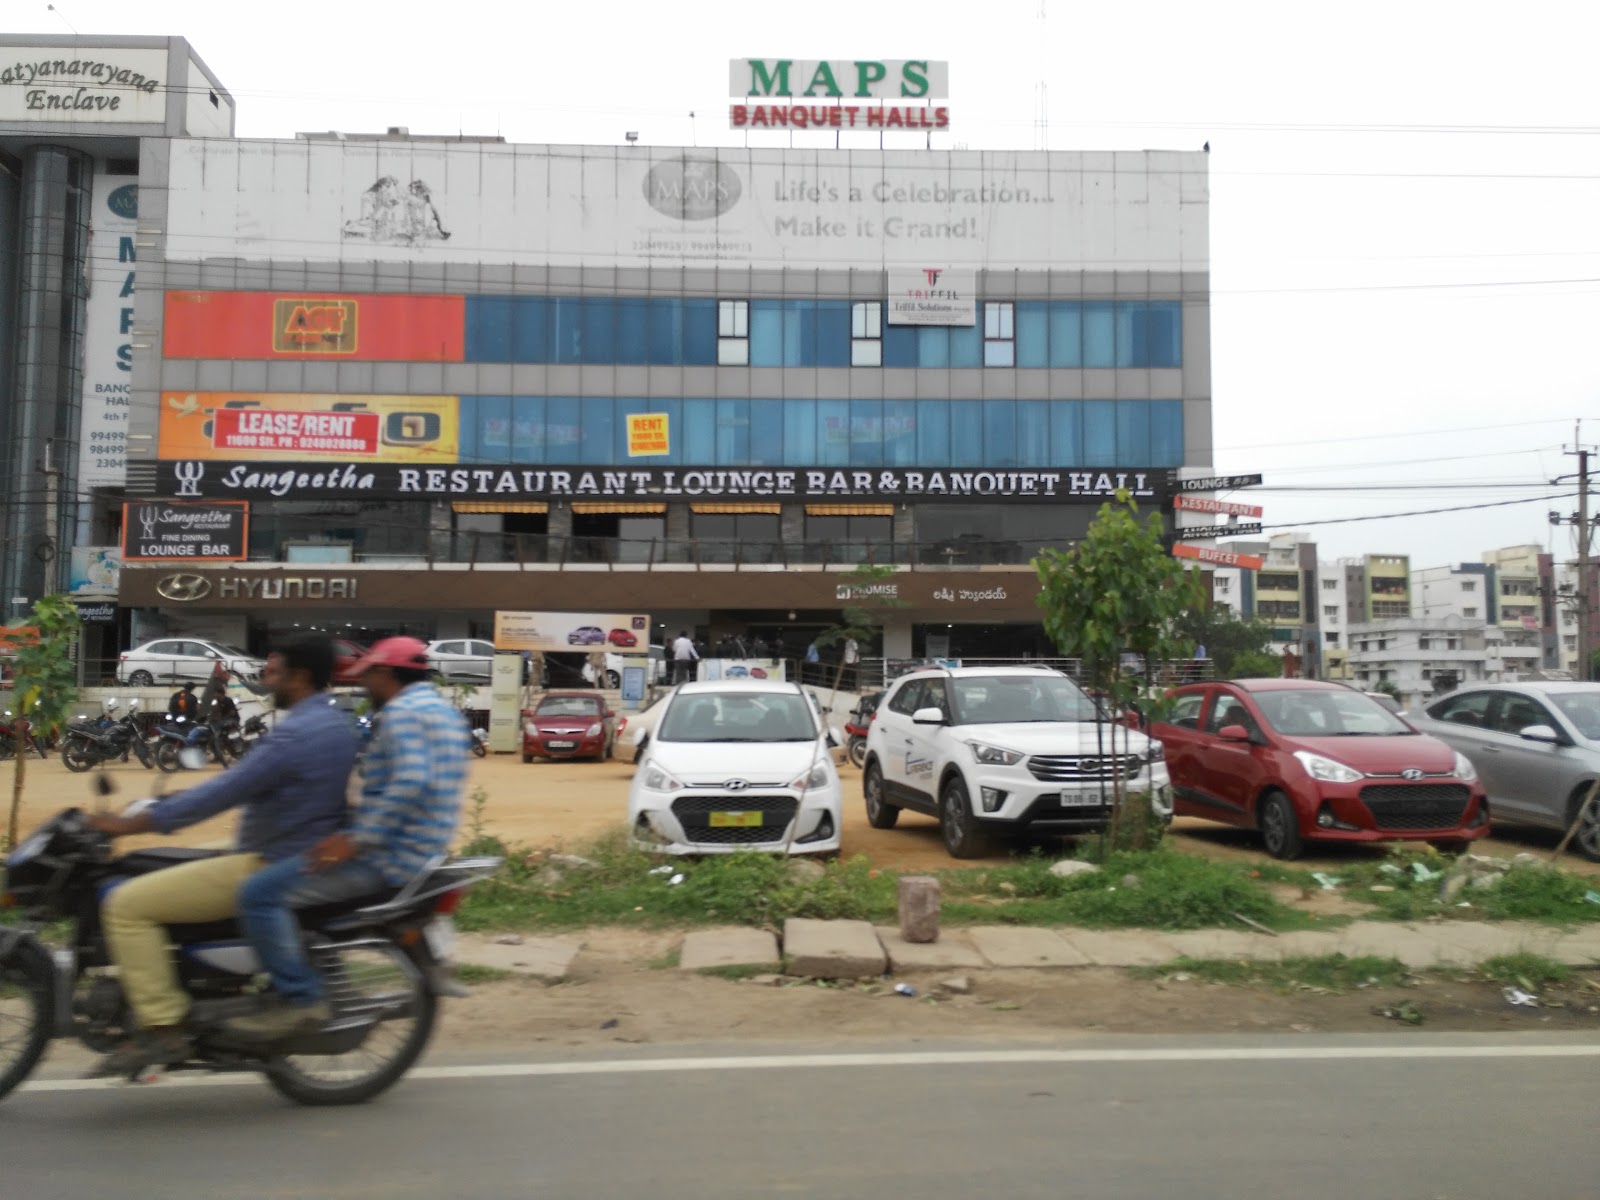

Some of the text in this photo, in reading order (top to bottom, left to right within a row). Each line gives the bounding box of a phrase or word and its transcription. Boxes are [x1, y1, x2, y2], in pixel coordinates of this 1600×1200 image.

[748, 60, 930, 98] MAPS
[26, 87, 120, 110] Enclave
[732, 105, 949, 128] BANQUET HALLS
[655, 179, 729, 201] MAPS
[775, 180, 839, 203] Life's
[850, 187, 862, 202] a
[775, 215, 976, 238] Make it Grand!
[908, 290, 959, 300] TRIFFIL
[286, 306, 347, 333] ACT
[103, 413, 120, 421] 4th
[238, 412, 355, 437] LEASE/RENT
[633, 418, 662, 431] RENT
[91, 432, 127, 440] 99499
[89, 445, 127, 454] 98499
[221, 463, 375, 496] Sangeetha
[399, 469, 651, 495] RESTAURANT
[661, 471, 796, 496] LOUNGE
[1068, 473, 1154, 496] HALL
[1181, 498, 1255, 516] RESTAURANT
[158, 508, 231, 529] Sangeetha
[182, 534, 211, 542] DINING
[141, 545, 230, 556] LOUNGE BAR
[219, 577, 357, 599] HYUNDAI
